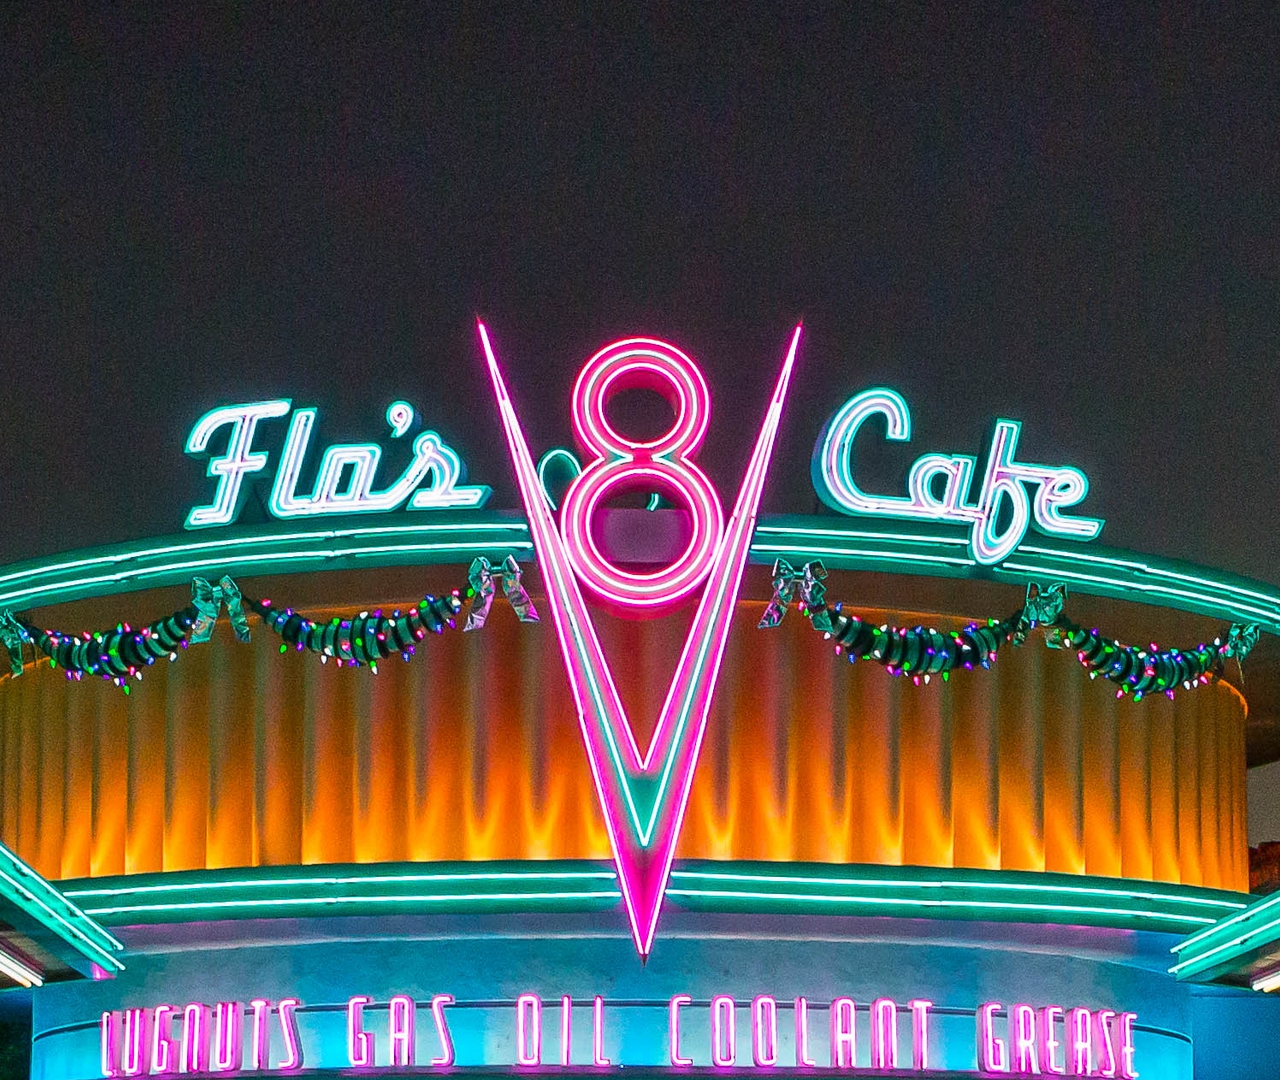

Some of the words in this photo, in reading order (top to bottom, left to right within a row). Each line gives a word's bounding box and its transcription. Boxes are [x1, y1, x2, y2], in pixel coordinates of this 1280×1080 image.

[184, 398, 492, 528] Flo's
[814, 387, 1105, 565] Cafe
[98, 998, 306, 1078] LUGNUTS
[347, 993, 455, 1068] GAS
[516, 993, 612, 1068] OIL
[668, 993, 935, 1071] COOLANT
[977, 1001, 1140, 1080] GREASE
